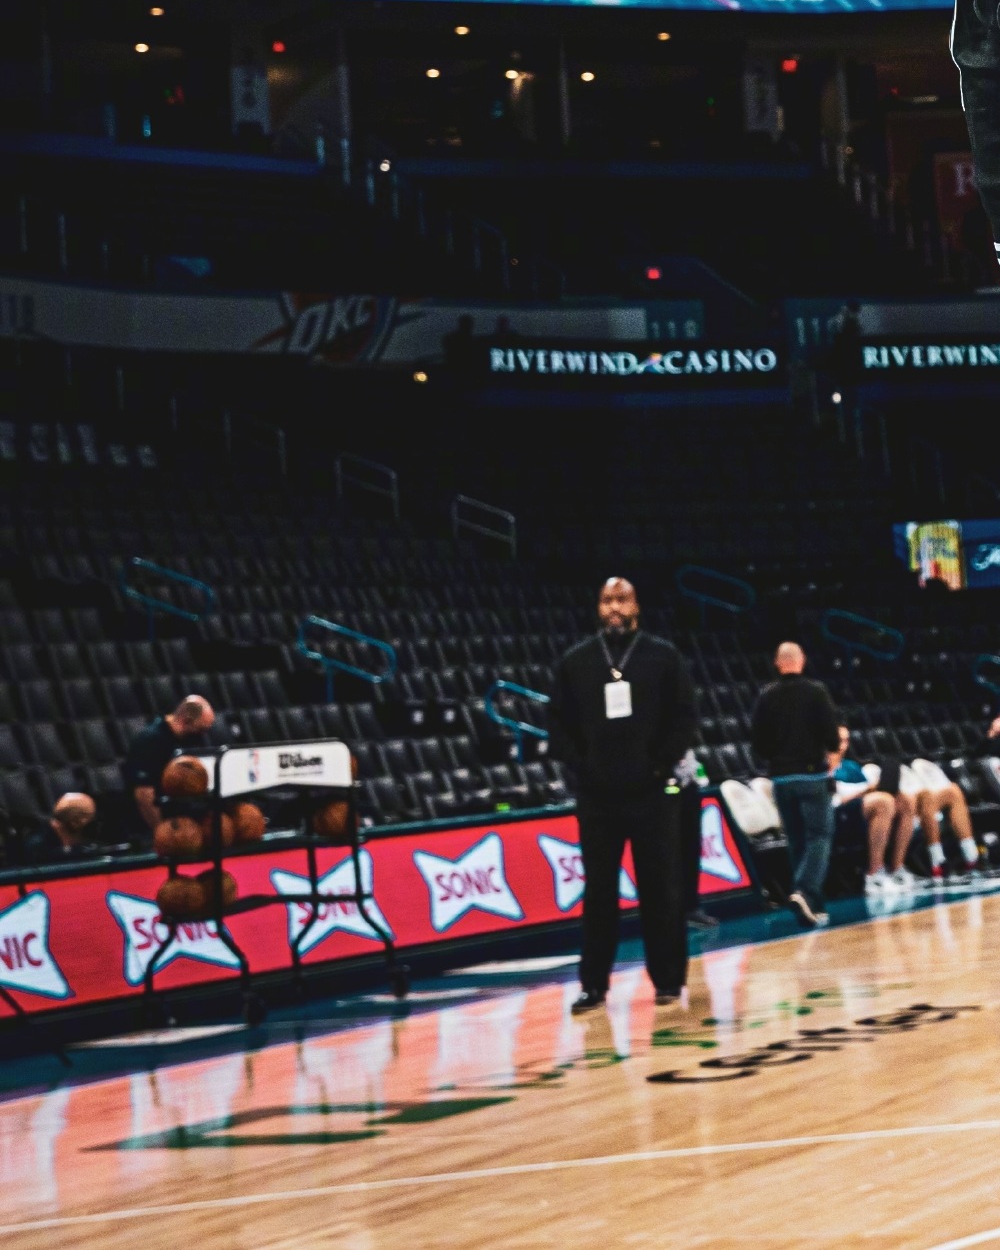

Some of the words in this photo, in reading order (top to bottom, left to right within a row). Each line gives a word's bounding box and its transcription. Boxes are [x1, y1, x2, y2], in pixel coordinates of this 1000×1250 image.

[297, 294, 374, 352] OKC
[489, 347, 641, 376] RIVERWIND
[661, 348, 777, 375] CASINO
[434, 866, 501, 902] SONIC
